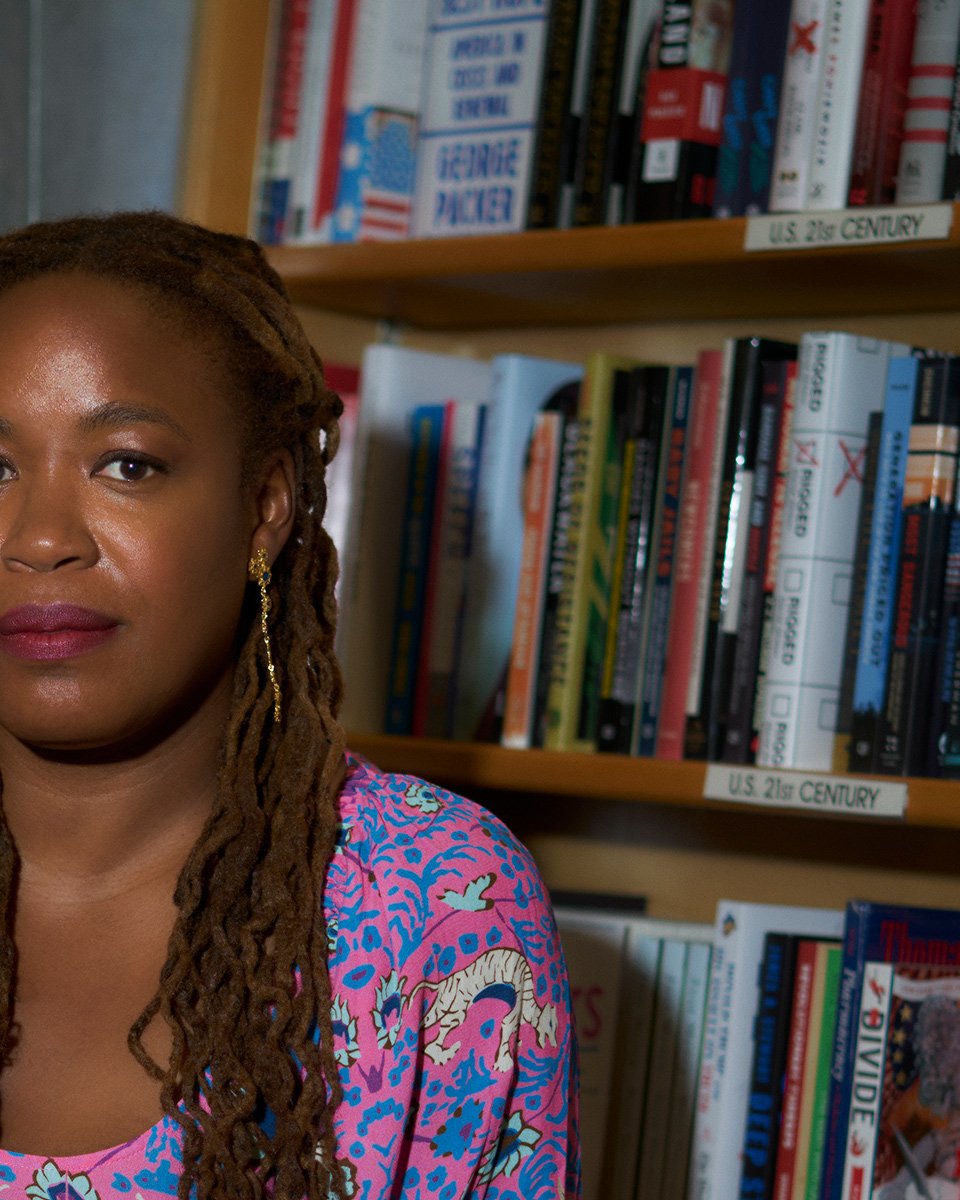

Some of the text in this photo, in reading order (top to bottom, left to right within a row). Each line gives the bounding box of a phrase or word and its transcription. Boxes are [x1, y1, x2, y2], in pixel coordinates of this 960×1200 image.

[438, 138, 520, 180] GEORGE
[433, 186, 514, 226] PACKER
[769, 221, 798, 244] U.S.
[840, 213, 925, 240] CENTURY
[808, 342, 828, 413] RIGGED
[795, 469, 815, 539] RIGGED
[903, 513, 920, 556] MOST
[656, 504, 677, 577] JAILS
[876, 554, 892, 621] PRICED
[895, 561, 916, 649] DANGEROUS
[782, 597, 802, 667] RIGGED
[870, 628, 884, 665] OUT
[728, 773, 757, 798] U.S.
[799, 780, 880, 809] CENTURY
[852, 1009, 886, 1128] DIVIDE
[746, 1092, 775, 1168] DEEP
